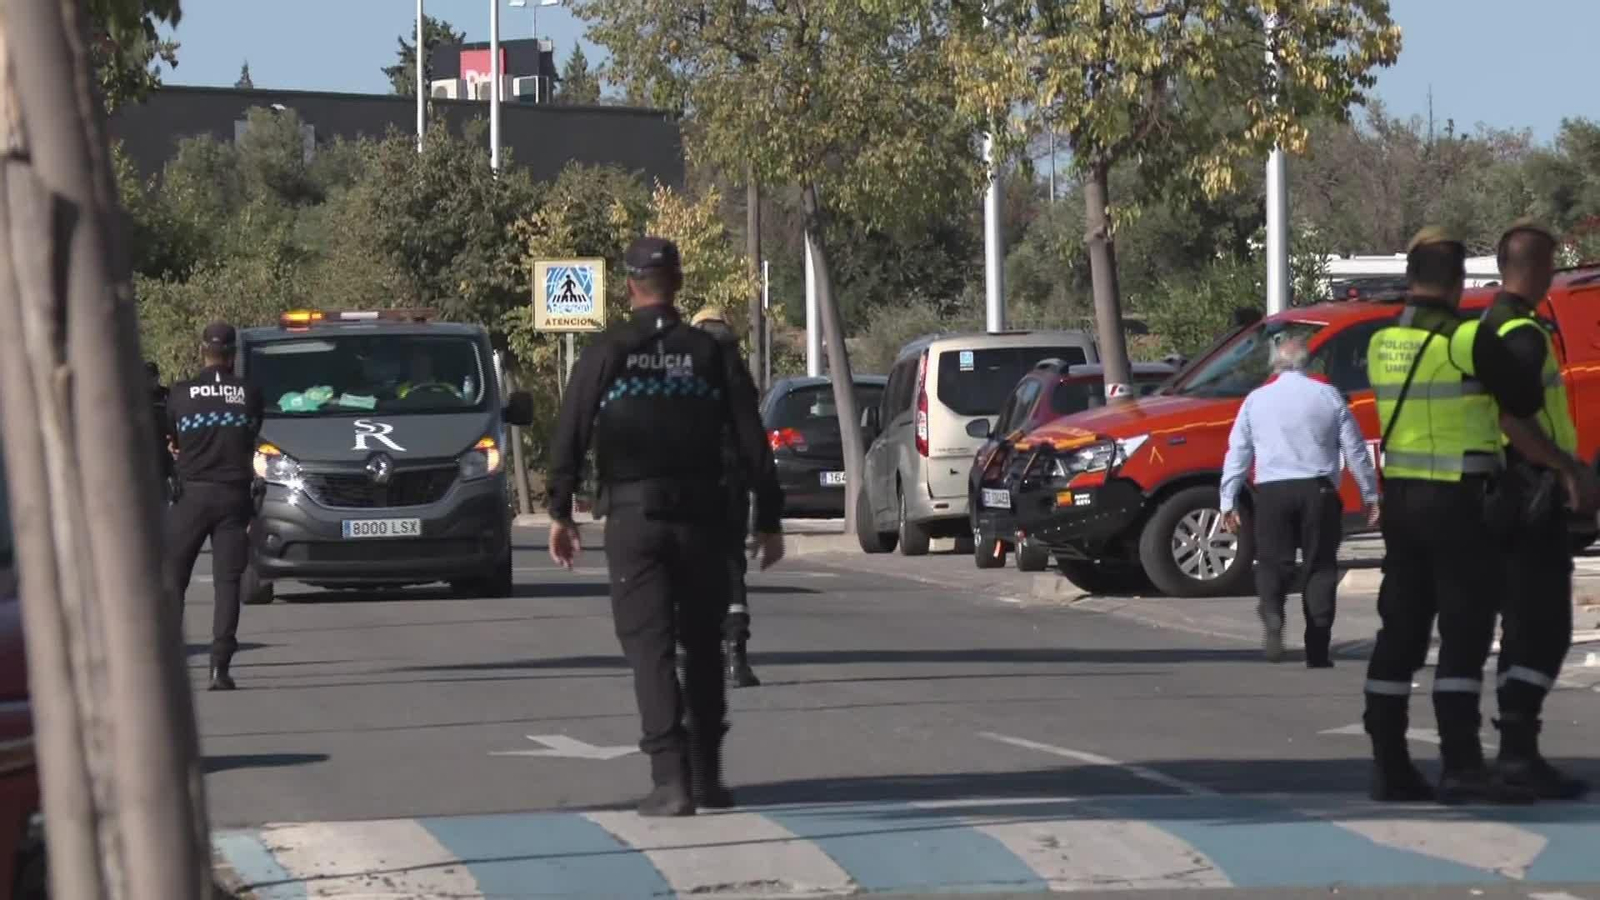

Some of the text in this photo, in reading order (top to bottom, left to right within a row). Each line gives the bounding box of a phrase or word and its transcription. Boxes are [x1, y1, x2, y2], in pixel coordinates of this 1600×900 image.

[627, 353, 692, 369] POLICIA
[189, 385, 245, 399] POLICIA
[353, 520, 418, 535] 8000 LSX
